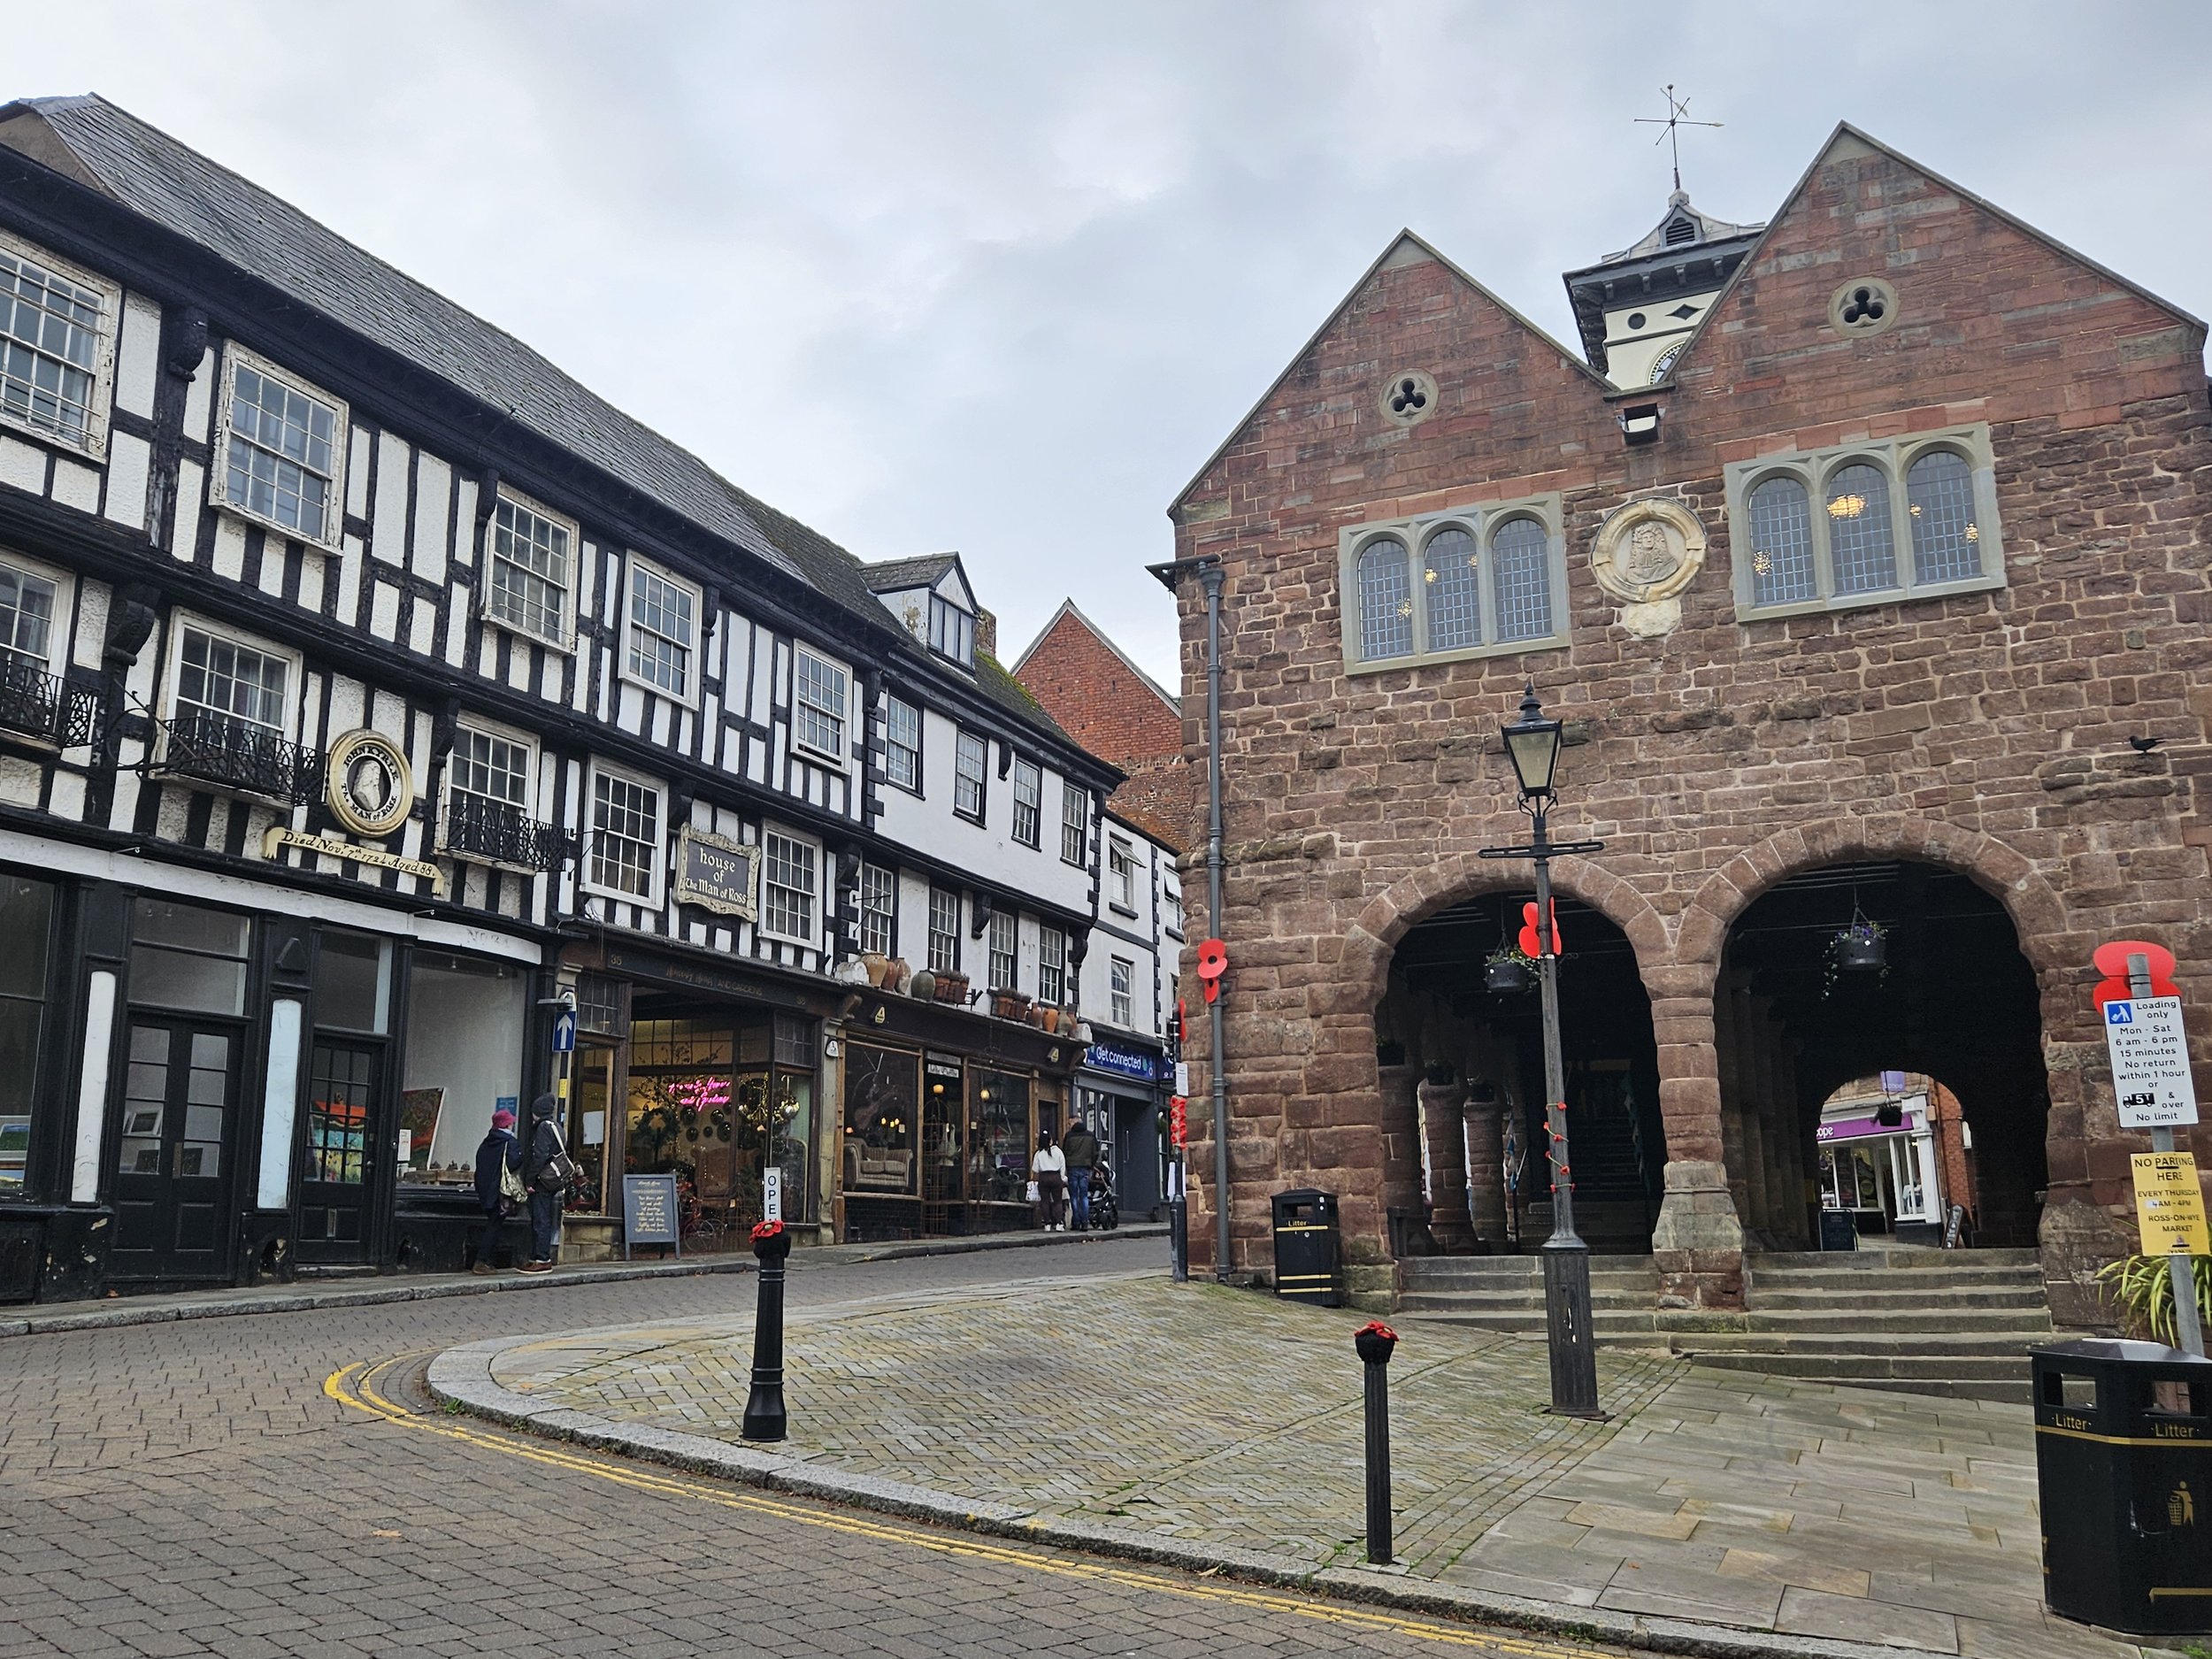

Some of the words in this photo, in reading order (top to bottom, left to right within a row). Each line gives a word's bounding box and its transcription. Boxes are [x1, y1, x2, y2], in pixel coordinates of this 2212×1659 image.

[350, 803, 372, 821] MAN
[282, 831, 315, 847] Died
[388, 856, 419, 872] Aged
[700, 847, 736, 872] house
[713, 870, 725, 883] of
[699, 879, 719, 897] Man
[720, 888, 728, 899] of
[728, 887, 747, 904] Ross
[2136, 1001, 2177, 1010] Loading
[1095, 1046, 1109, 1062] Get
[1109, 1052, 1142, 1071] connected
[2135, 1048, 2177, 1056] minutes
[2118, 1071, 2151, 1080] within
[2135, 1093, 2151, 1104] 5T
[2162, 1100, 2184, 1109] over
[2154, 1112, 2178, 1121] limit
[2134, 1157, 2153, 1168] NO
[2156, 1171, 2184, 1181] HERE
[768, 1175, 777, 1220] OPE
[2055, 1413, 2088, 1431] Litter
[2154, 1422, 2194, 1438] Litter
